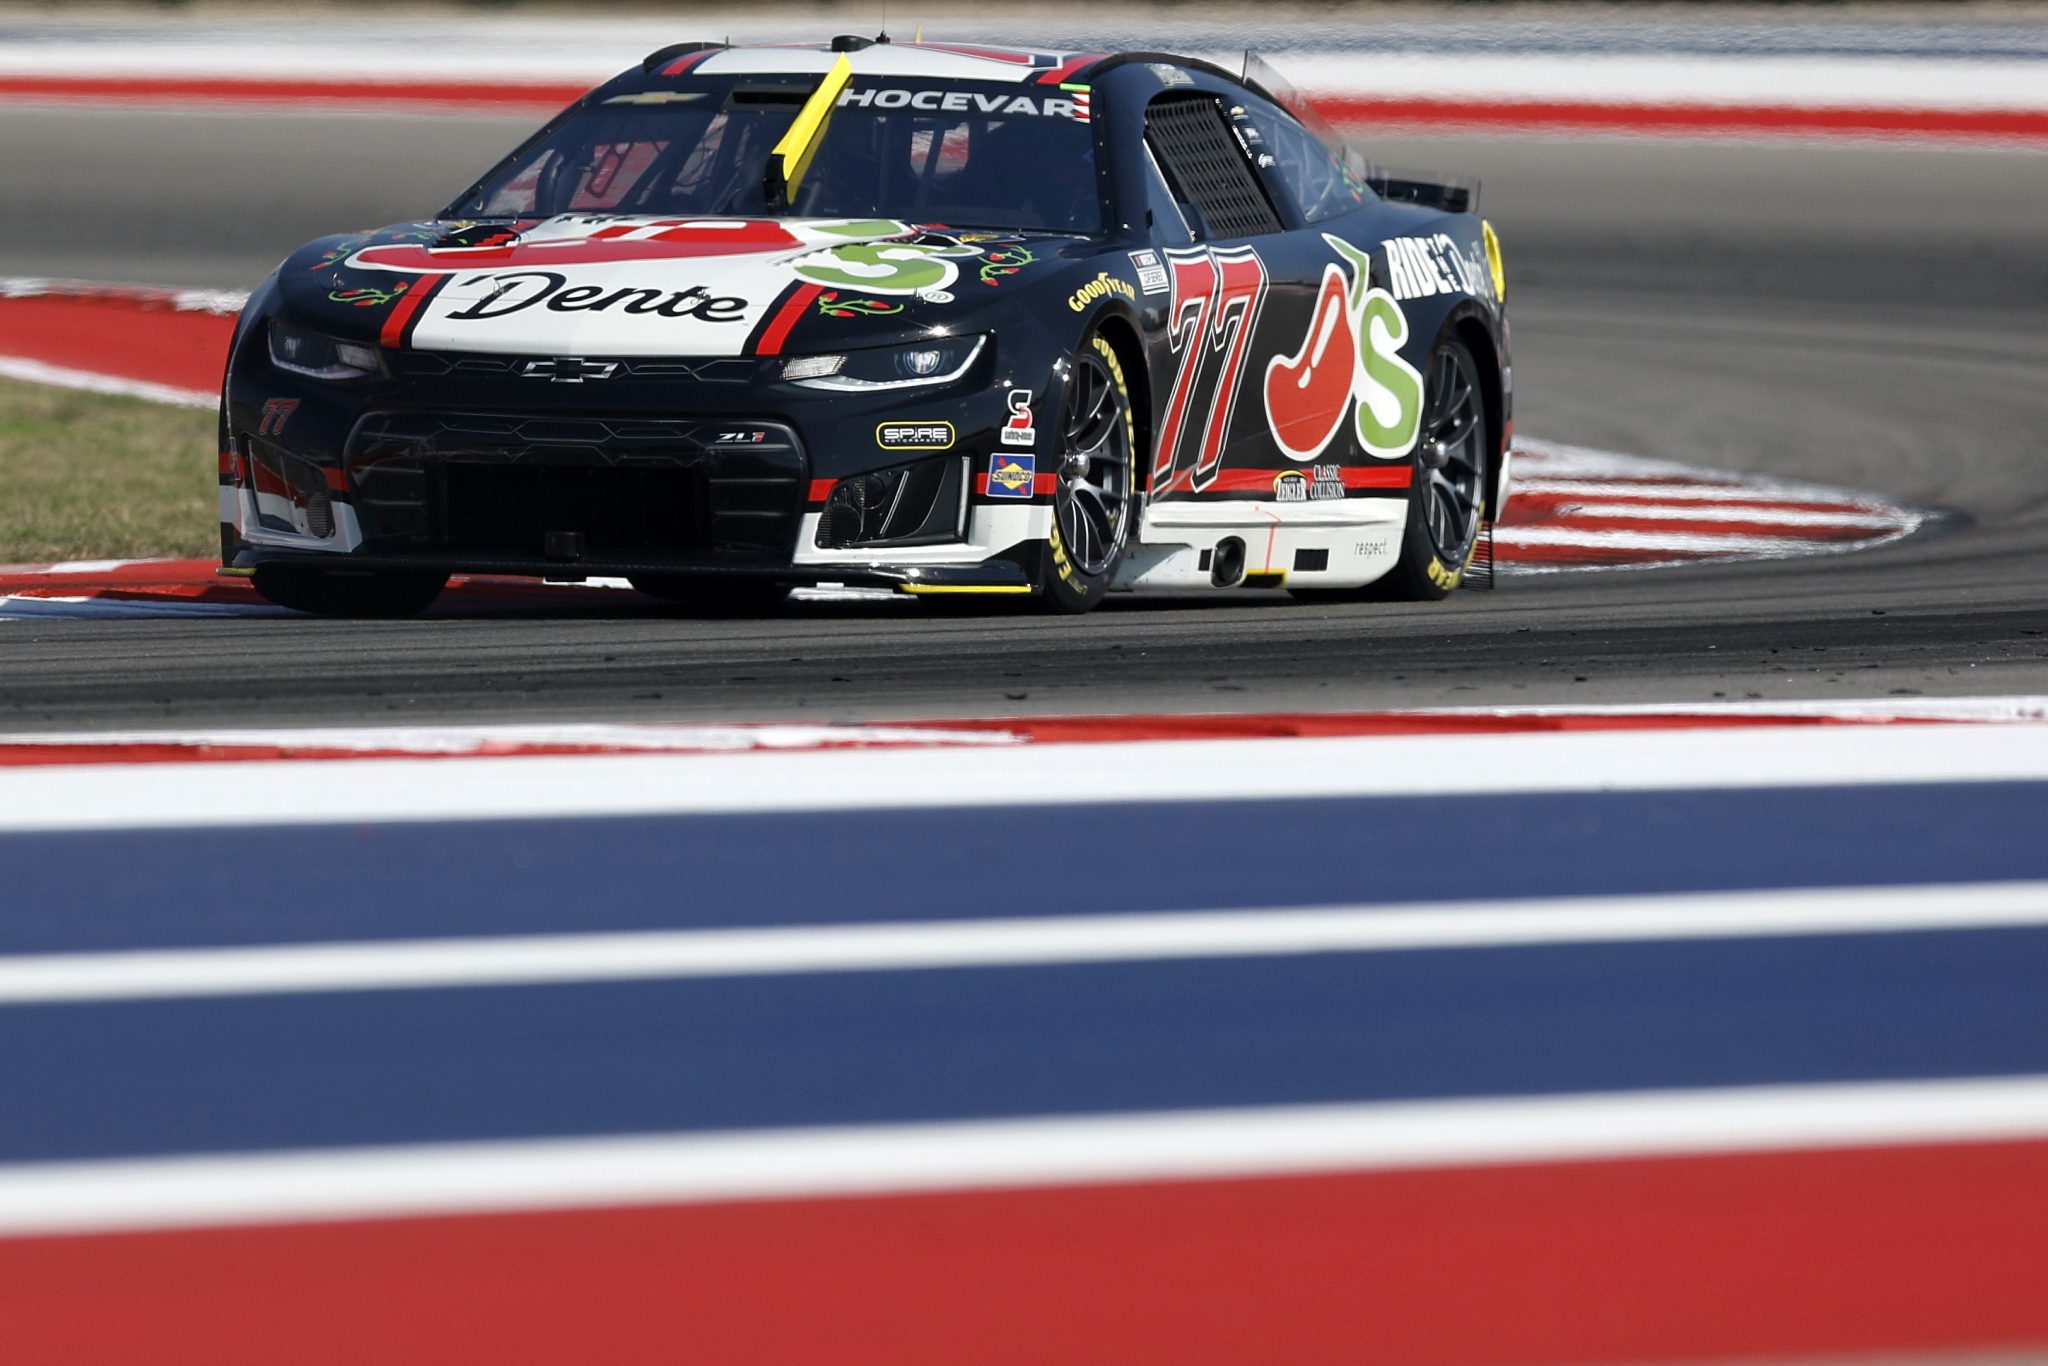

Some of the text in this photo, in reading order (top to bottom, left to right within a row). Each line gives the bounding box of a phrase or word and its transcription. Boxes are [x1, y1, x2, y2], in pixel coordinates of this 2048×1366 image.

[837, 88, 1076, 118] HOCEVAR
[1380, 236, 1453, 300] RIDE
[1068, 272, 1136, 312] GOODYEAR
[1152, 244, 1270, 494] 77
[258, 397, 302, 436] 77
[715, 432, 766, 443] ZL1
[884, 426, 948, 439] SPIRE
[993, 470, 1031, 482] SUNOCO
[1313, 464, 1341, 481] CLASSIC
[1310, 481, 1346, 499] COLLISION
